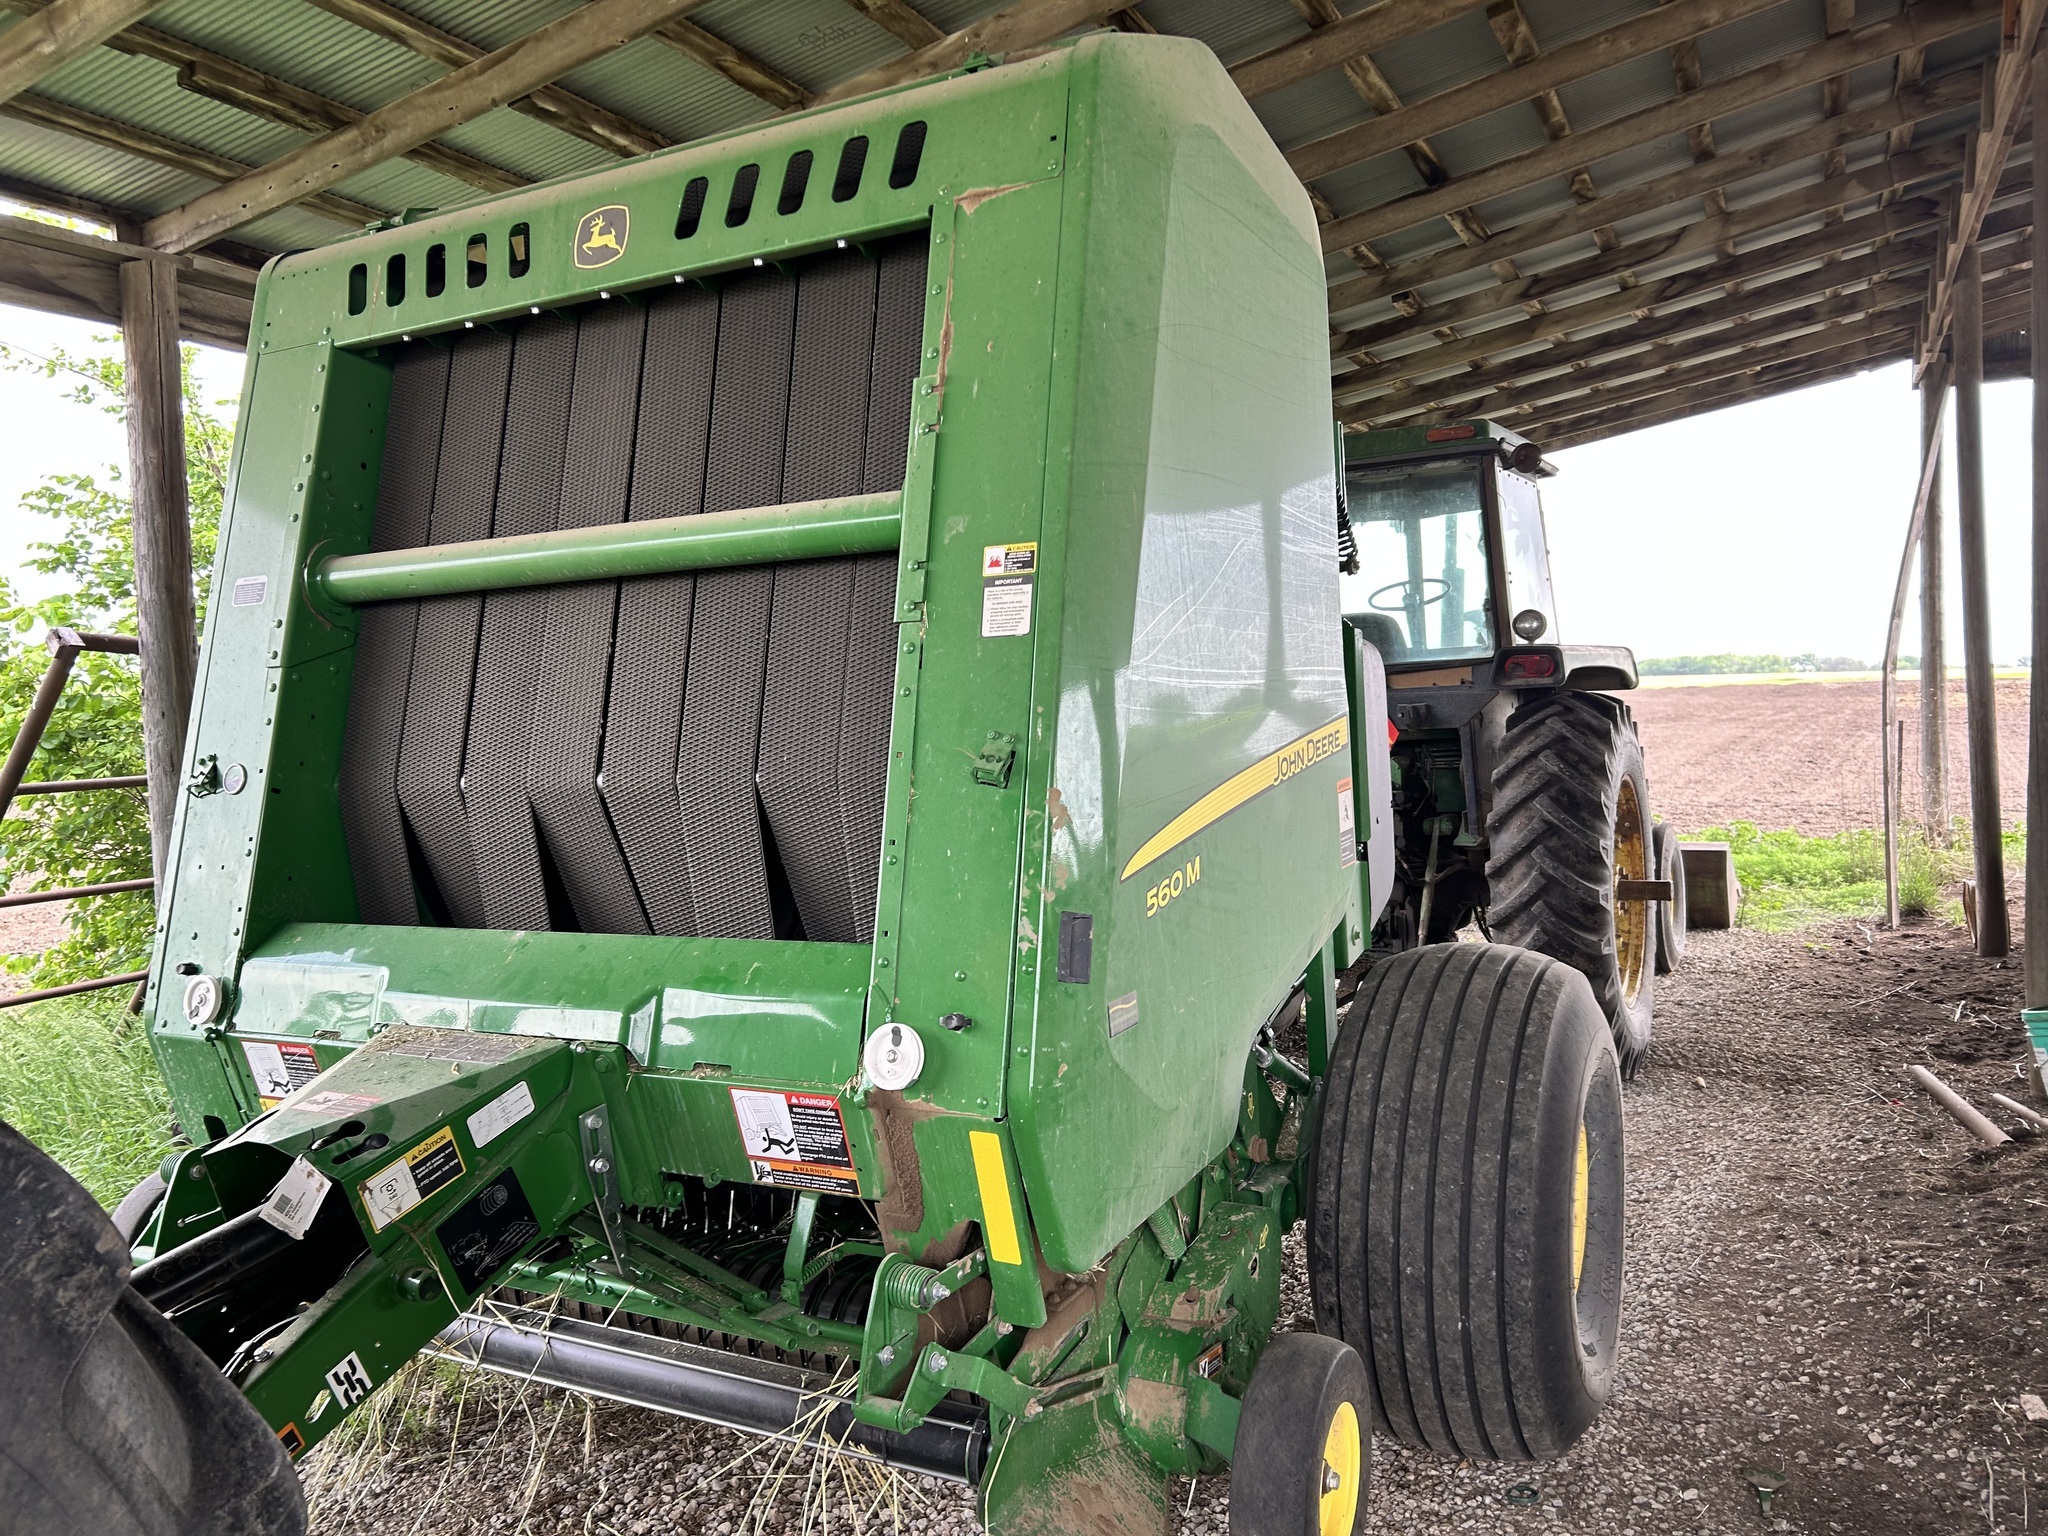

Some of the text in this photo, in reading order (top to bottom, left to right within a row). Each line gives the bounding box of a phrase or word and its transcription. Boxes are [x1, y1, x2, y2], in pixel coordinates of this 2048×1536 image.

[1274, 730, 1340, 783] JOHN DEERE
[1146, 870, 1184, 918] 560
[800, 1098, 833, 1107] DANGER
[418, 1134, 446, 1156] CAUTION
[798, 1166, 832, 1176] WARNING
